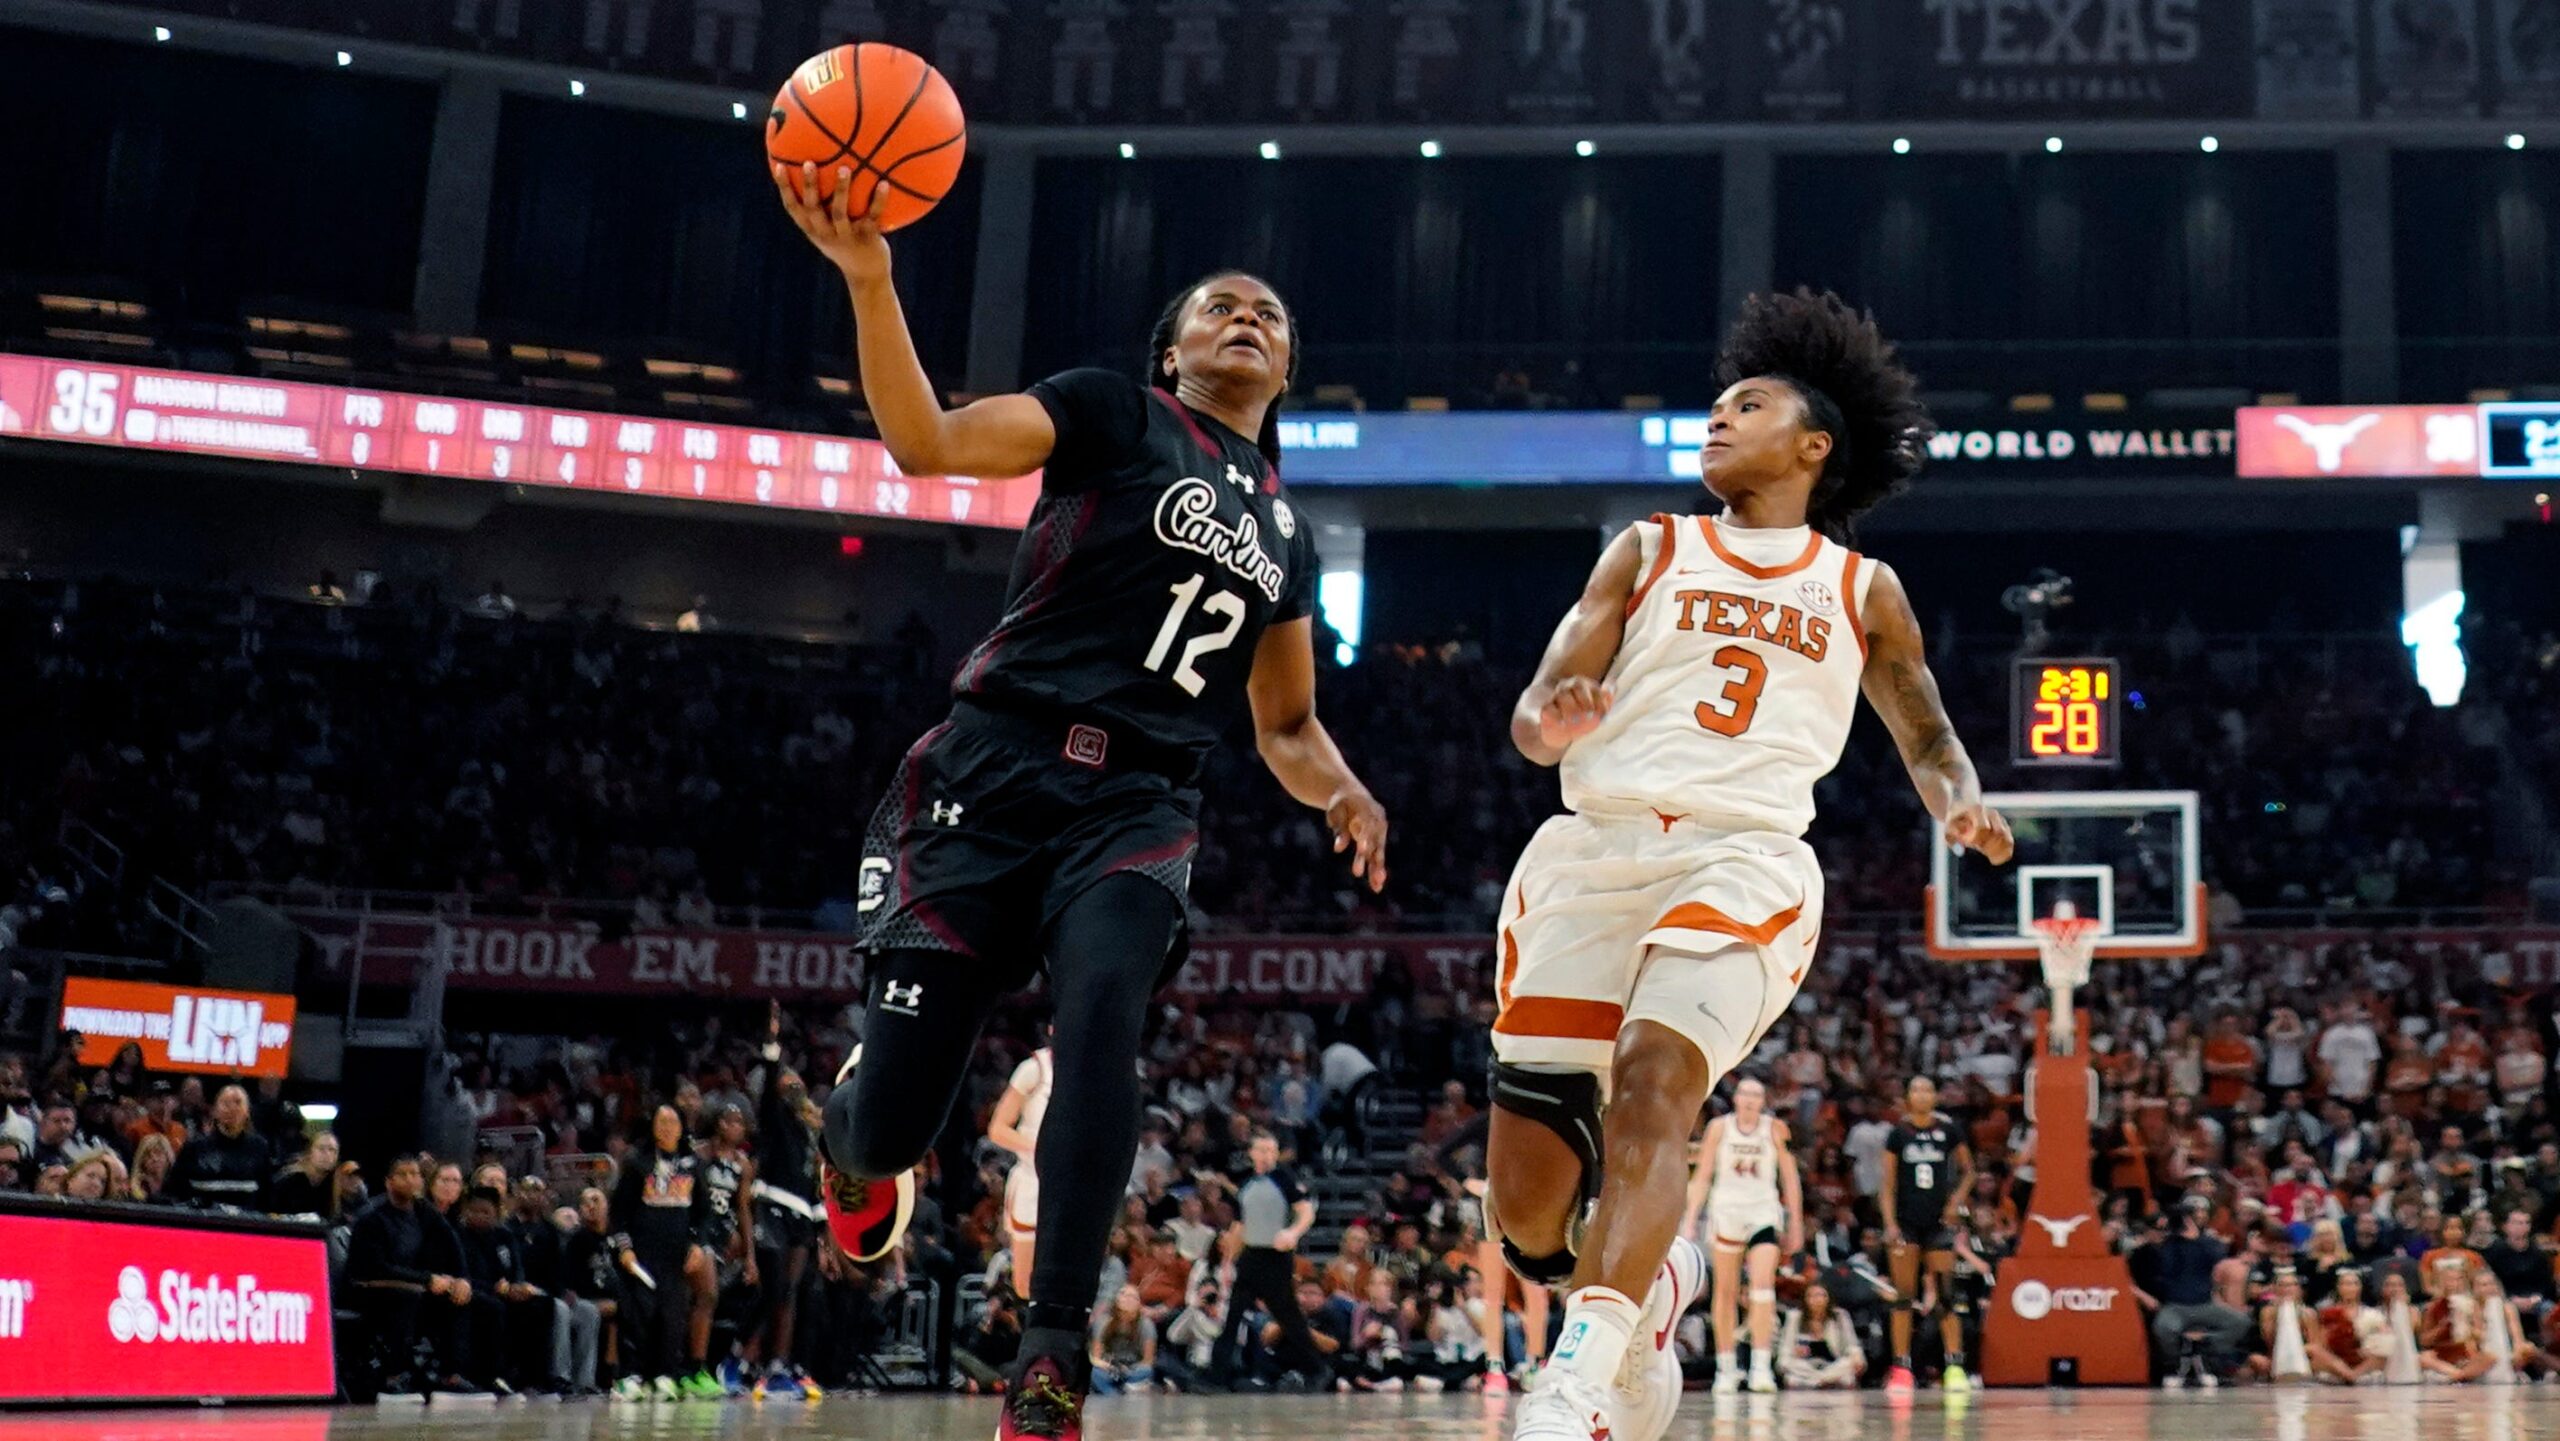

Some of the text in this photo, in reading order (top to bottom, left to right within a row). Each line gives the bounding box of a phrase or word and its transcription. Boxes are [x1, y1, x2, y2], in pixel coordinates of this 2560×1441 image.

[1924, 0, 2199, 64] TEXAS
[51, 368, 119, 436] 35
[344, 394, 383, 427] PTS
[428, 439, 440, 471] 1
[492, 446, 512, 478] 3
[559, 451, 576, 484] 4
[624, 457, 643, 490] 3
[693, 464, 705, 496] 1
[755, 469, 773, 502] 2
[1927, 429, 2235, 458] WORLD WALLET
[1154, 476, 1284, 602] Carolina
[1143, 573, 1246, 698] 12
[1675, 589, 1831, 663] TEXAS
[1694, 645, 1768, 737] 3
[2040, 669, 2108, 701] 2:31
[2031, 702, 2099, 754] 28
[445, 925, 597, 979] HOOK
[754, 943, 863, 988] HOR
[62, 1006, 144, 1038] DOWNLOAD
[1735, 1160, 1760, 1178] 44
